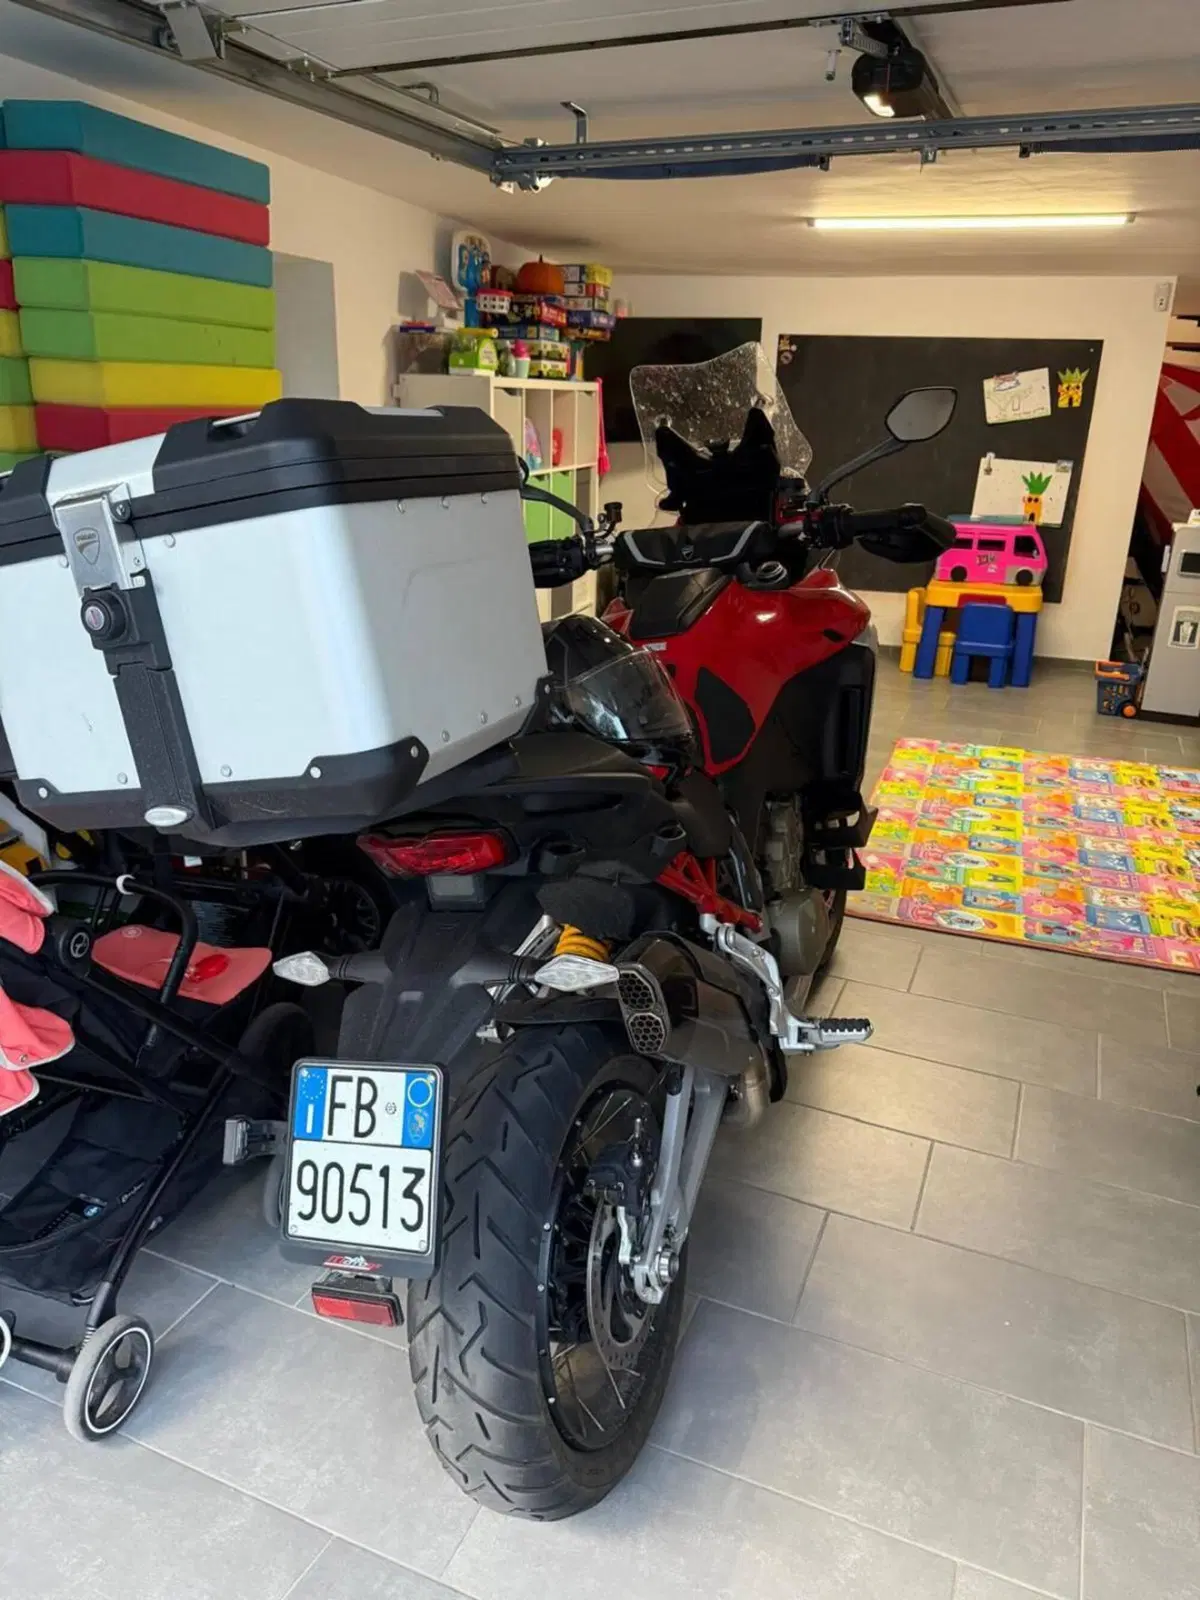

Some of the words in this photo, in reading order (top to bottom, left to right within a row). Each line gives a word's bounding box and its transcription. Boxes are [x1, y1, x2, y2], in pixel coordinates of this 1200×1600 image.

[305, 1103, 315, 1134] I
[327, 1074, 379, 1138] FB
[296, 1159, 426, 1232] 90513
